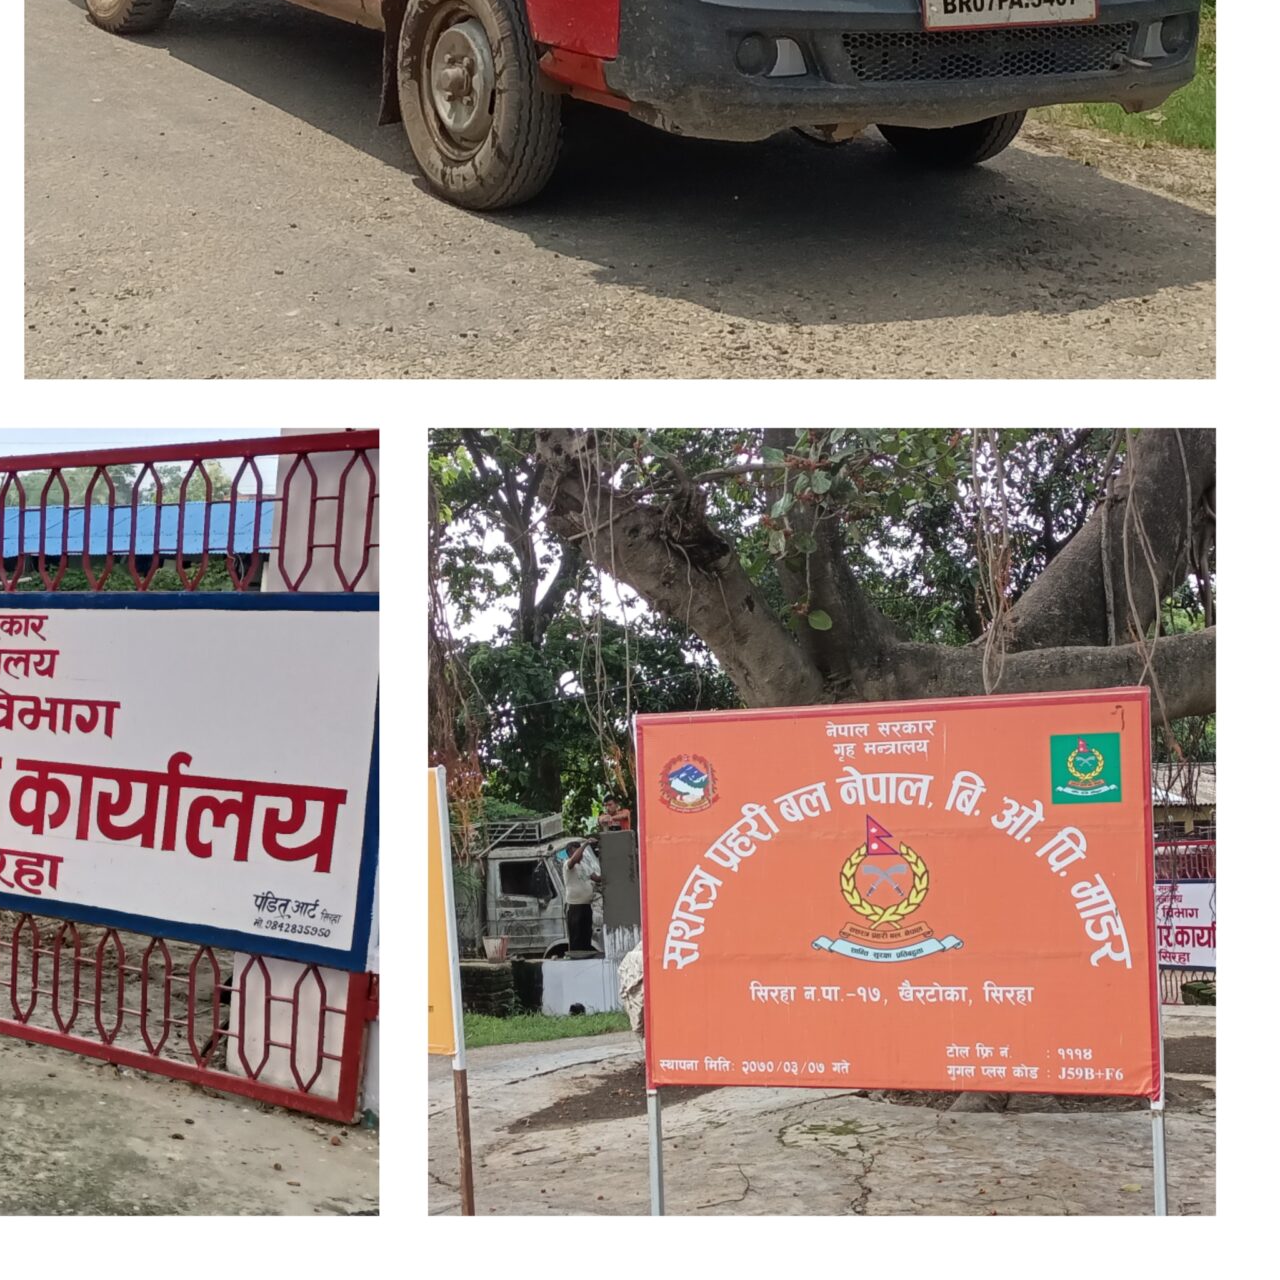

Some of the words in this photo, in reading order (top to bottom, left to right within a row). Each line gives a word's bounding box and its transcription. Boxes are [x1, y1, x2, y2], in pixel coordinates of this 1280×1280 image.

[825, 721, 870, 738] नेपाल
[876, 720, 937, 738] सरकार
[833, 743, 857, 762] गृह
[863, 739, 930, 756] मन्त्रालय
[9, 751, 348, 873] कार्यालय
[663, 864, 723, 970] सशस्त्र
[703, 802, 780, 872] प्रहरी
[773, 781, 832, 823] बल
[835, 766, 934, 809] नेपाल,
[944, 770, 987, 816] बि.
[991, 796, 1045, 843] ओ.
[1035, 826, 1087, 877] पि.
[1070, 873, 1132, 969] माडर
[291, 899, 320, 918] आर्ट
[749, 980, 796, 1005] सिरहा
[983, 980, 1034, 1006] सिरहा
[946, 1043, 970, 1059] टोल
[975, 1042, 994, 1059] फ्रि
[1057, 1047, 1093, 1061] १११४
[659, 1058, 699, 1072] स्थापना
[832, 1059, 850, 1074] गते
[946, 1065, 976, 1081] गुगल
[980, 1065, 1007, 1079] प्लस
[1012, 1063, 1040, 1079] कोड
[1058, 1067, 1123, 1081] J59B+F6
